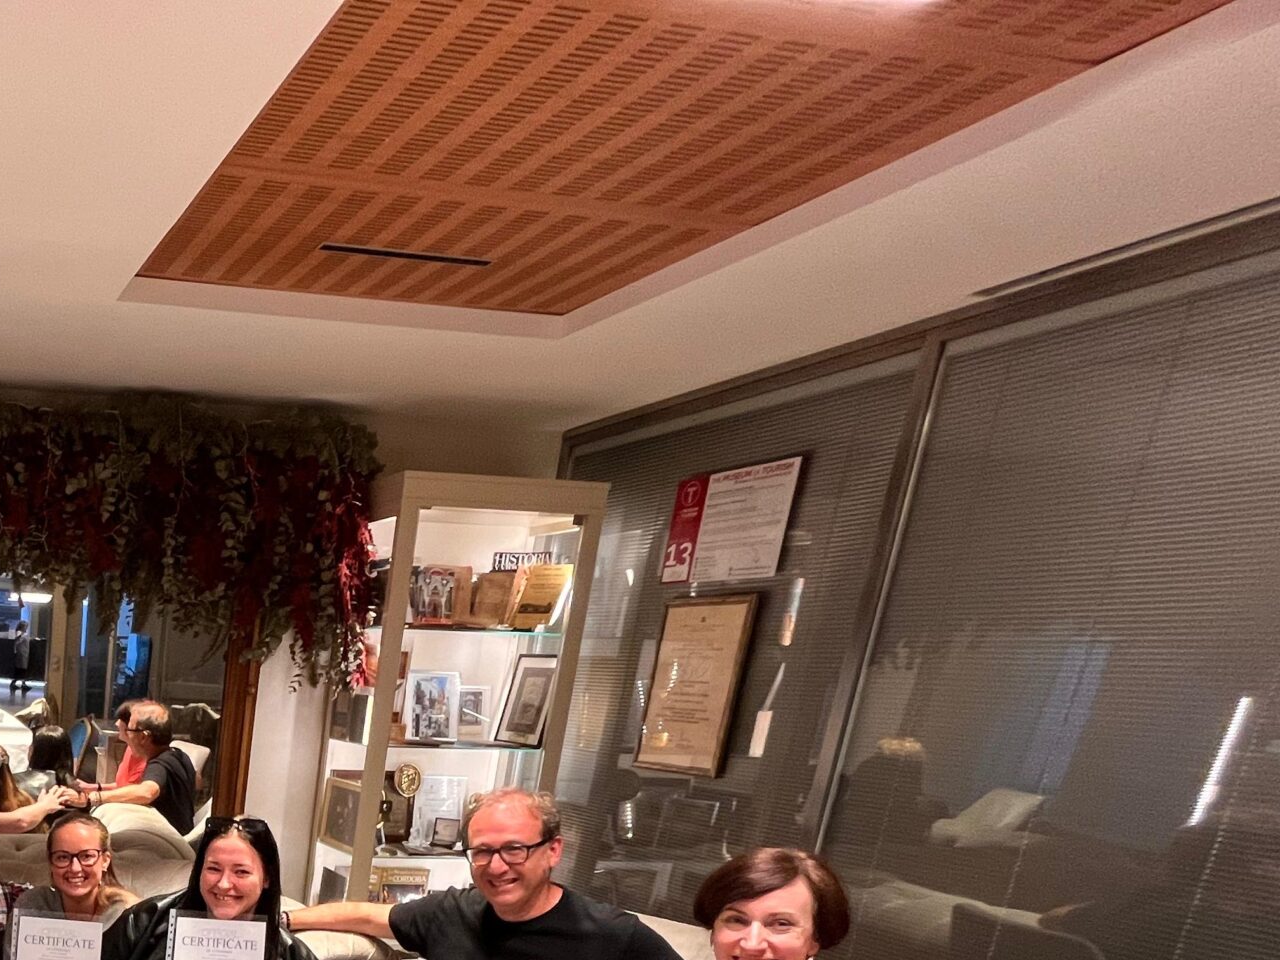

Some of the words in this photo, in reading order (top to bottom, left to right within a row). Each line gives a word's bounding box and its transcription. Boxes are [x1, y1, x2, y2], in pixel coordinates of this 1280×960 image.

[665, 542, 692, 567] 13
[24, 934, 96, 950] CERTIFICATE
[182, 936, 258, 951] CERTIFICATE
